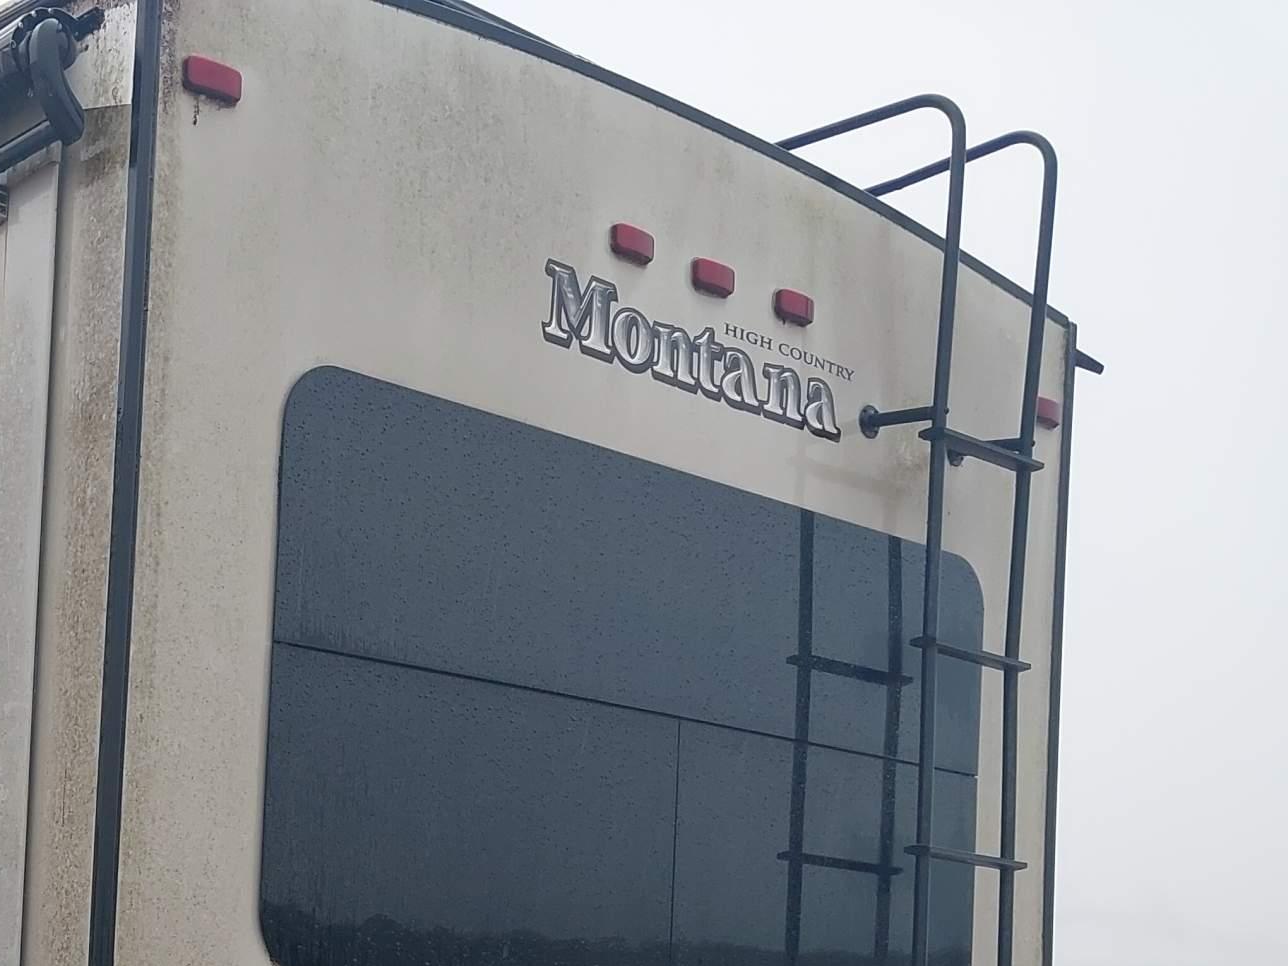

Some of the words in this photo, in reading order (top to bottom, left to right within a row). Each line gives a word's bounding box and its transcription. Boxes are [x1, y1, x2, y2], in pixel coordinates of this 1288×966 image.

[541, 258, 841, 442] Montana
[724, 323, 774, 351] HIGH
[778, 342, 855, 382] COUNTRY
